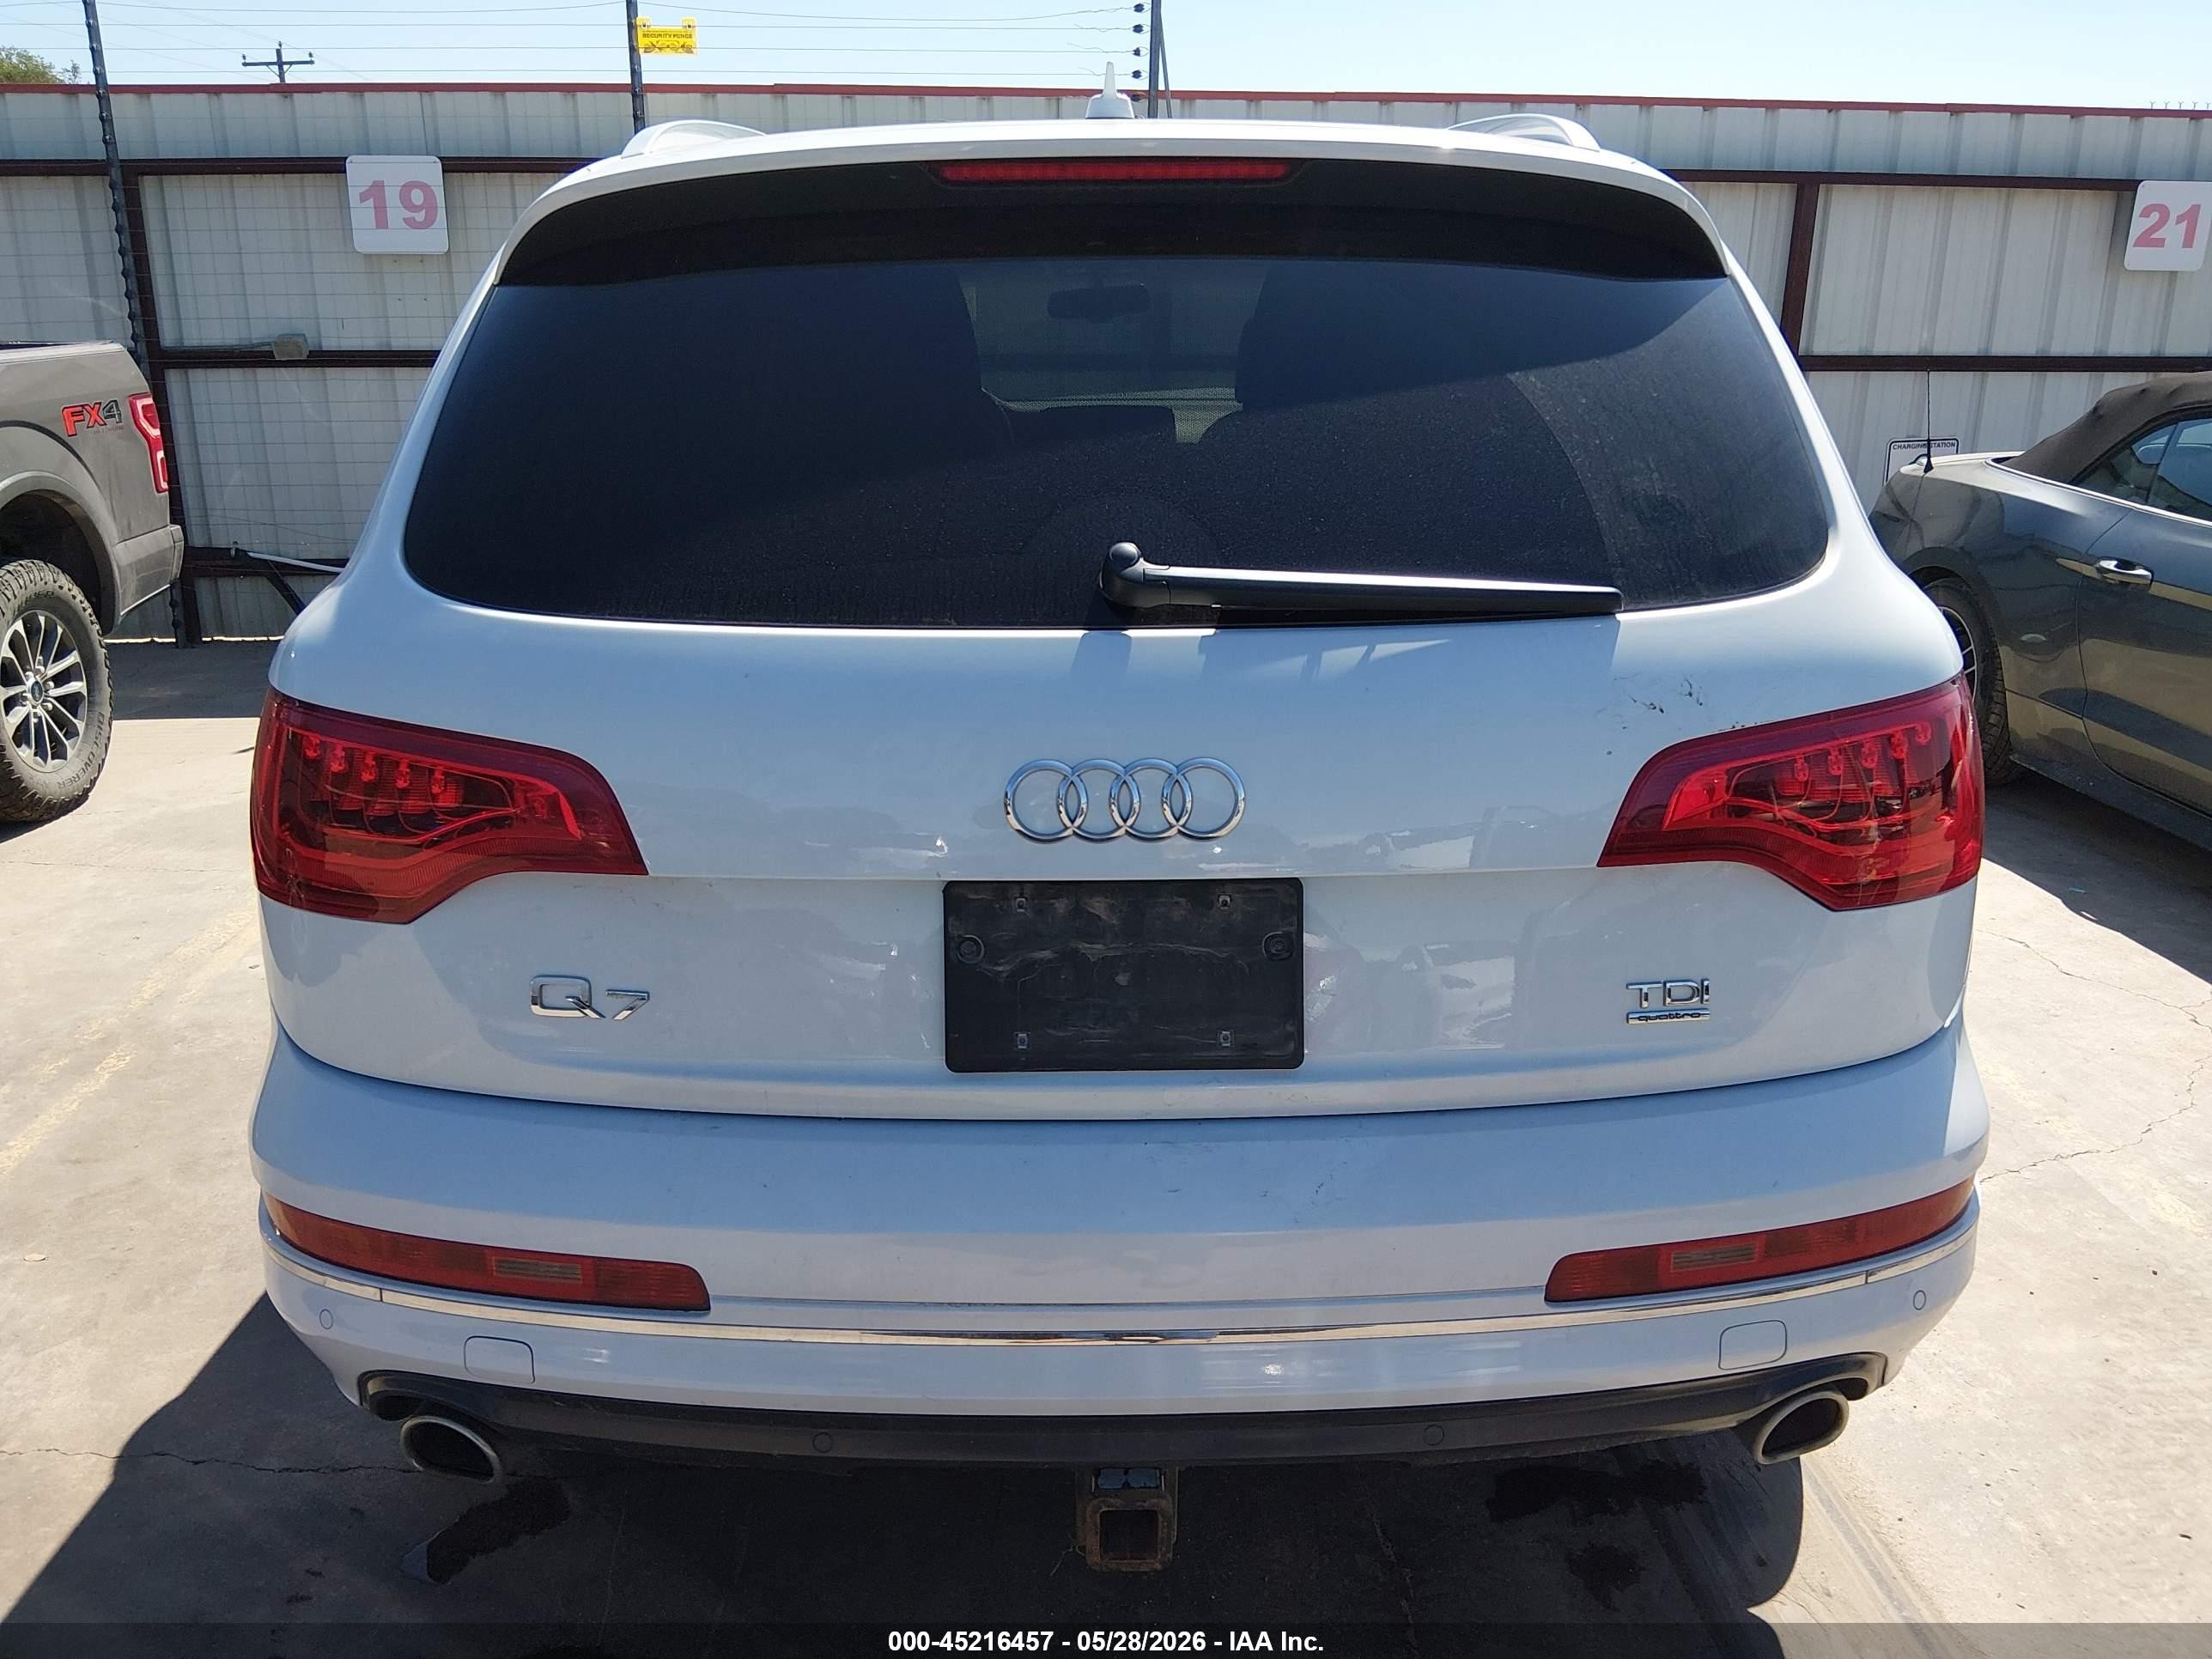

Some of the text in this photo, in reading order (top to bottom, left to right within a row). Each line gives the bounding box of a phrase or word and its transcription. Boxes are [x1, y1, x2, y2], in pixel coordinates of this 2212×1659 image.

[359, 179, 438, 230] 19
[2132, 204, 2201, 249] 21
[62, 399, 123, 437] FX4
[531, 975, 650, 1020] Q7
[1626, 978, 1710, 1009] TDI
[1638, 1012, 1701, 1023] quattro
